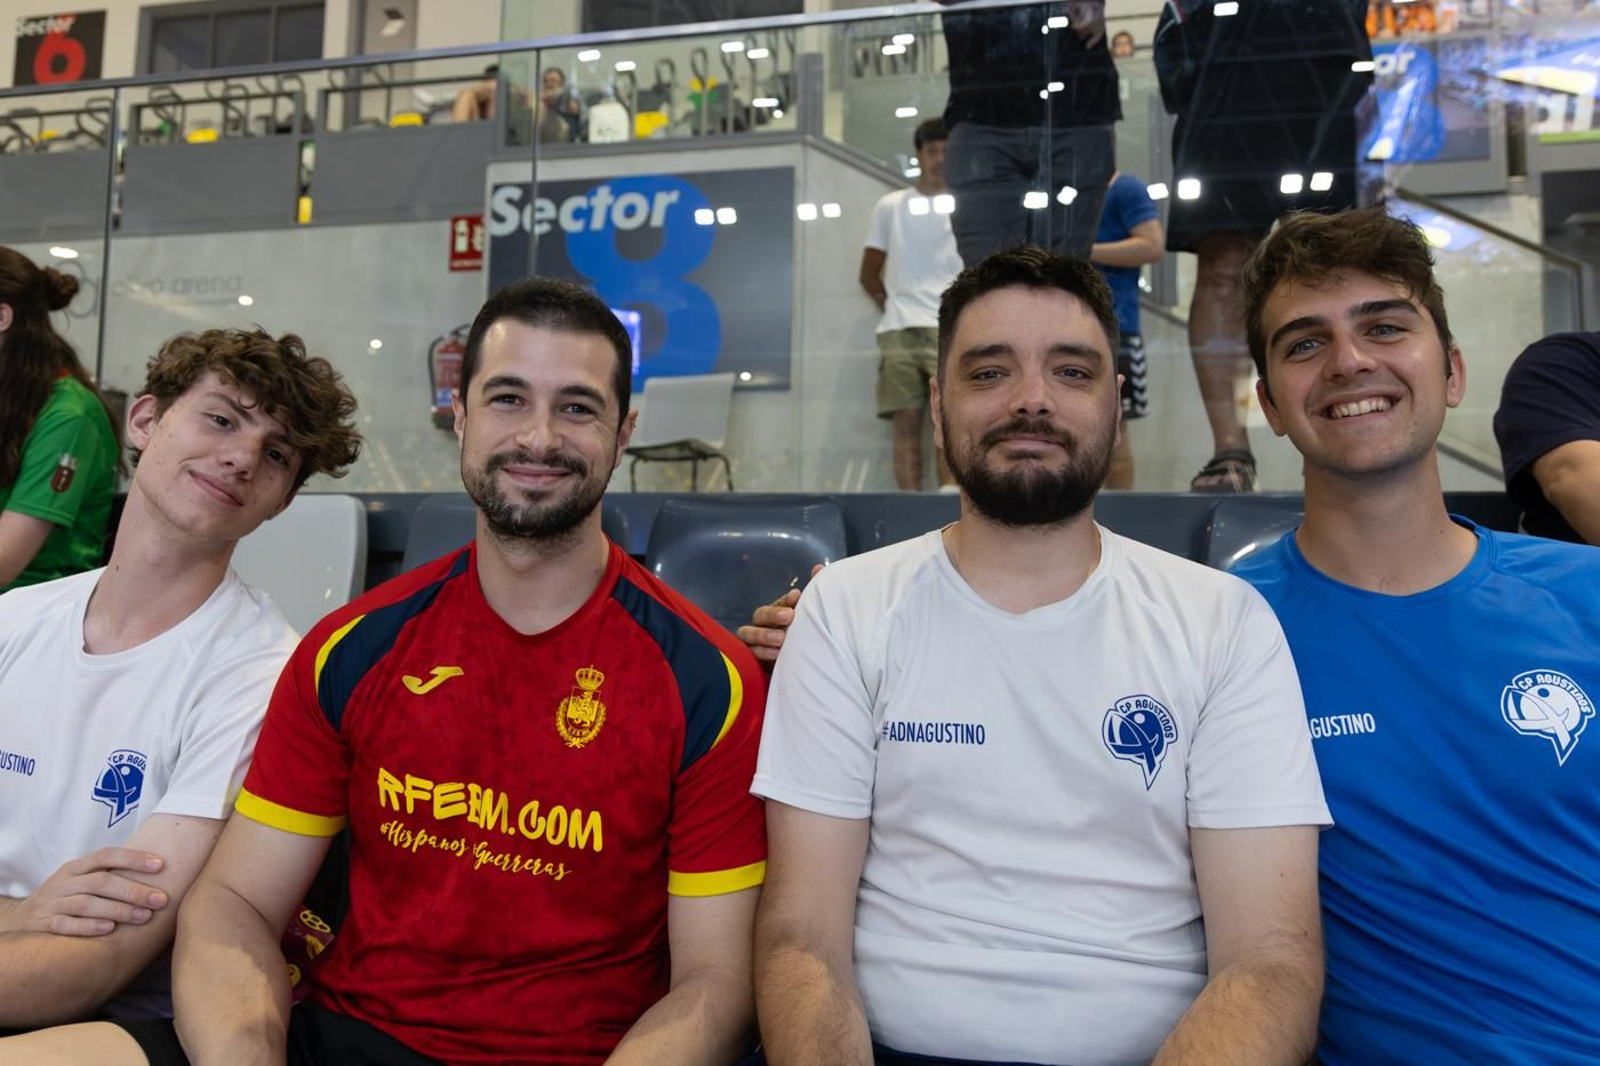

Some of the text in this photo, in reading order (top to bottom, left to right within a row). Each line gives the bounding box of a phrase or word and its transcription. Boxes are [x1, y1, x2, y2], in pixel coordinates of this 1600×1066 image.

[33, 13, 86, 84] 6
[490, 184, 680, 237] Sector
[566, 174, 722, 393] 8
[1518, 677, 1534, 690] CP
[1119, 699, 1174, 739] CP AGUSTINOS
[1309, 712, 1376, 739] GUSTINO
[112, 754, 124, 764] CP
[380, 820, 469, 857] #Hispanos
